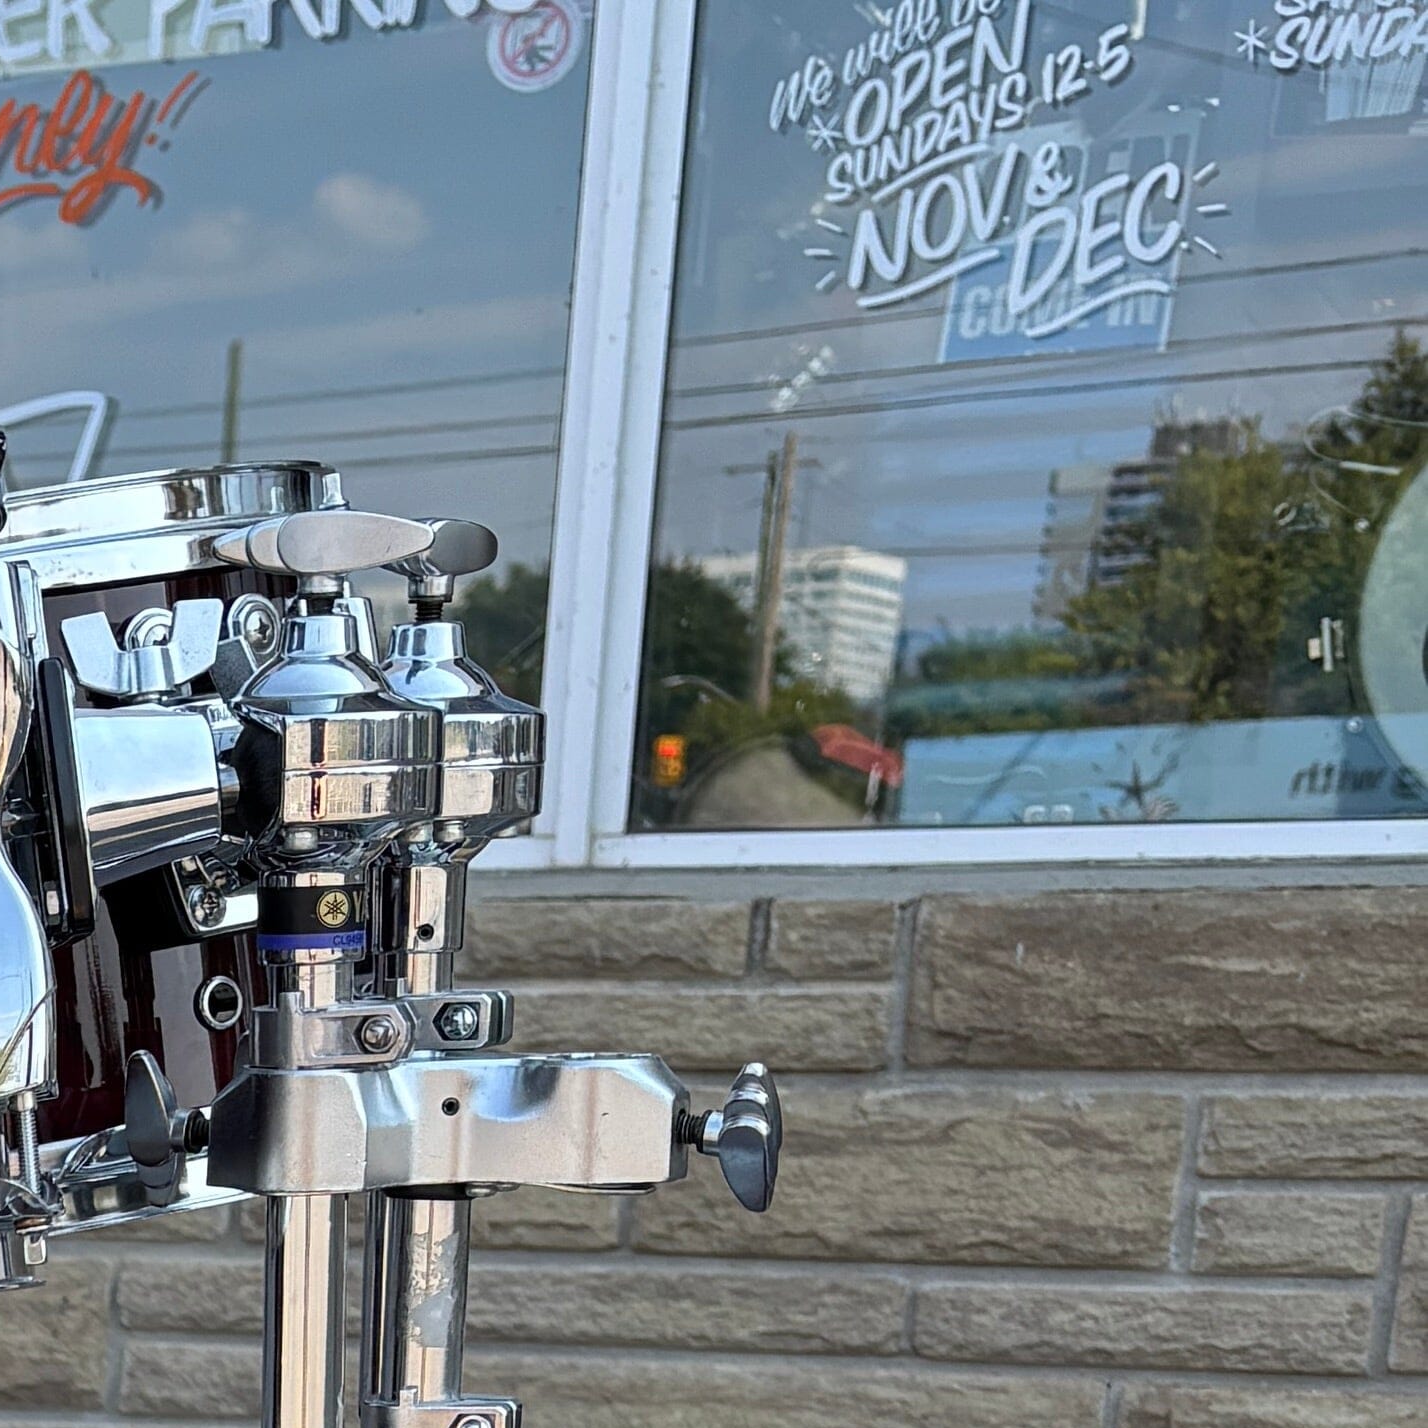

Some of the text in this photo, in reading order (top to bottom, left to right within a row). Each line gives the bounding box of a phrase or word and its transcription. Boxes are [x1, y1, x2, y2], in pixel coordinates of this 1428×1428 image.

[769, 55, 835, 131] We
[844, 0, 943, 86] will
[824, 72, 1028, 202] SUNDAYS
[1041, 23, 1131, 104] 12-5
[844, 0, 1031, 147] OPEN
[848, 142, 1020, 290] NOV.
[1008, 160, 1191, 316] DEC.
[1024, 140, 1074, 207] &
